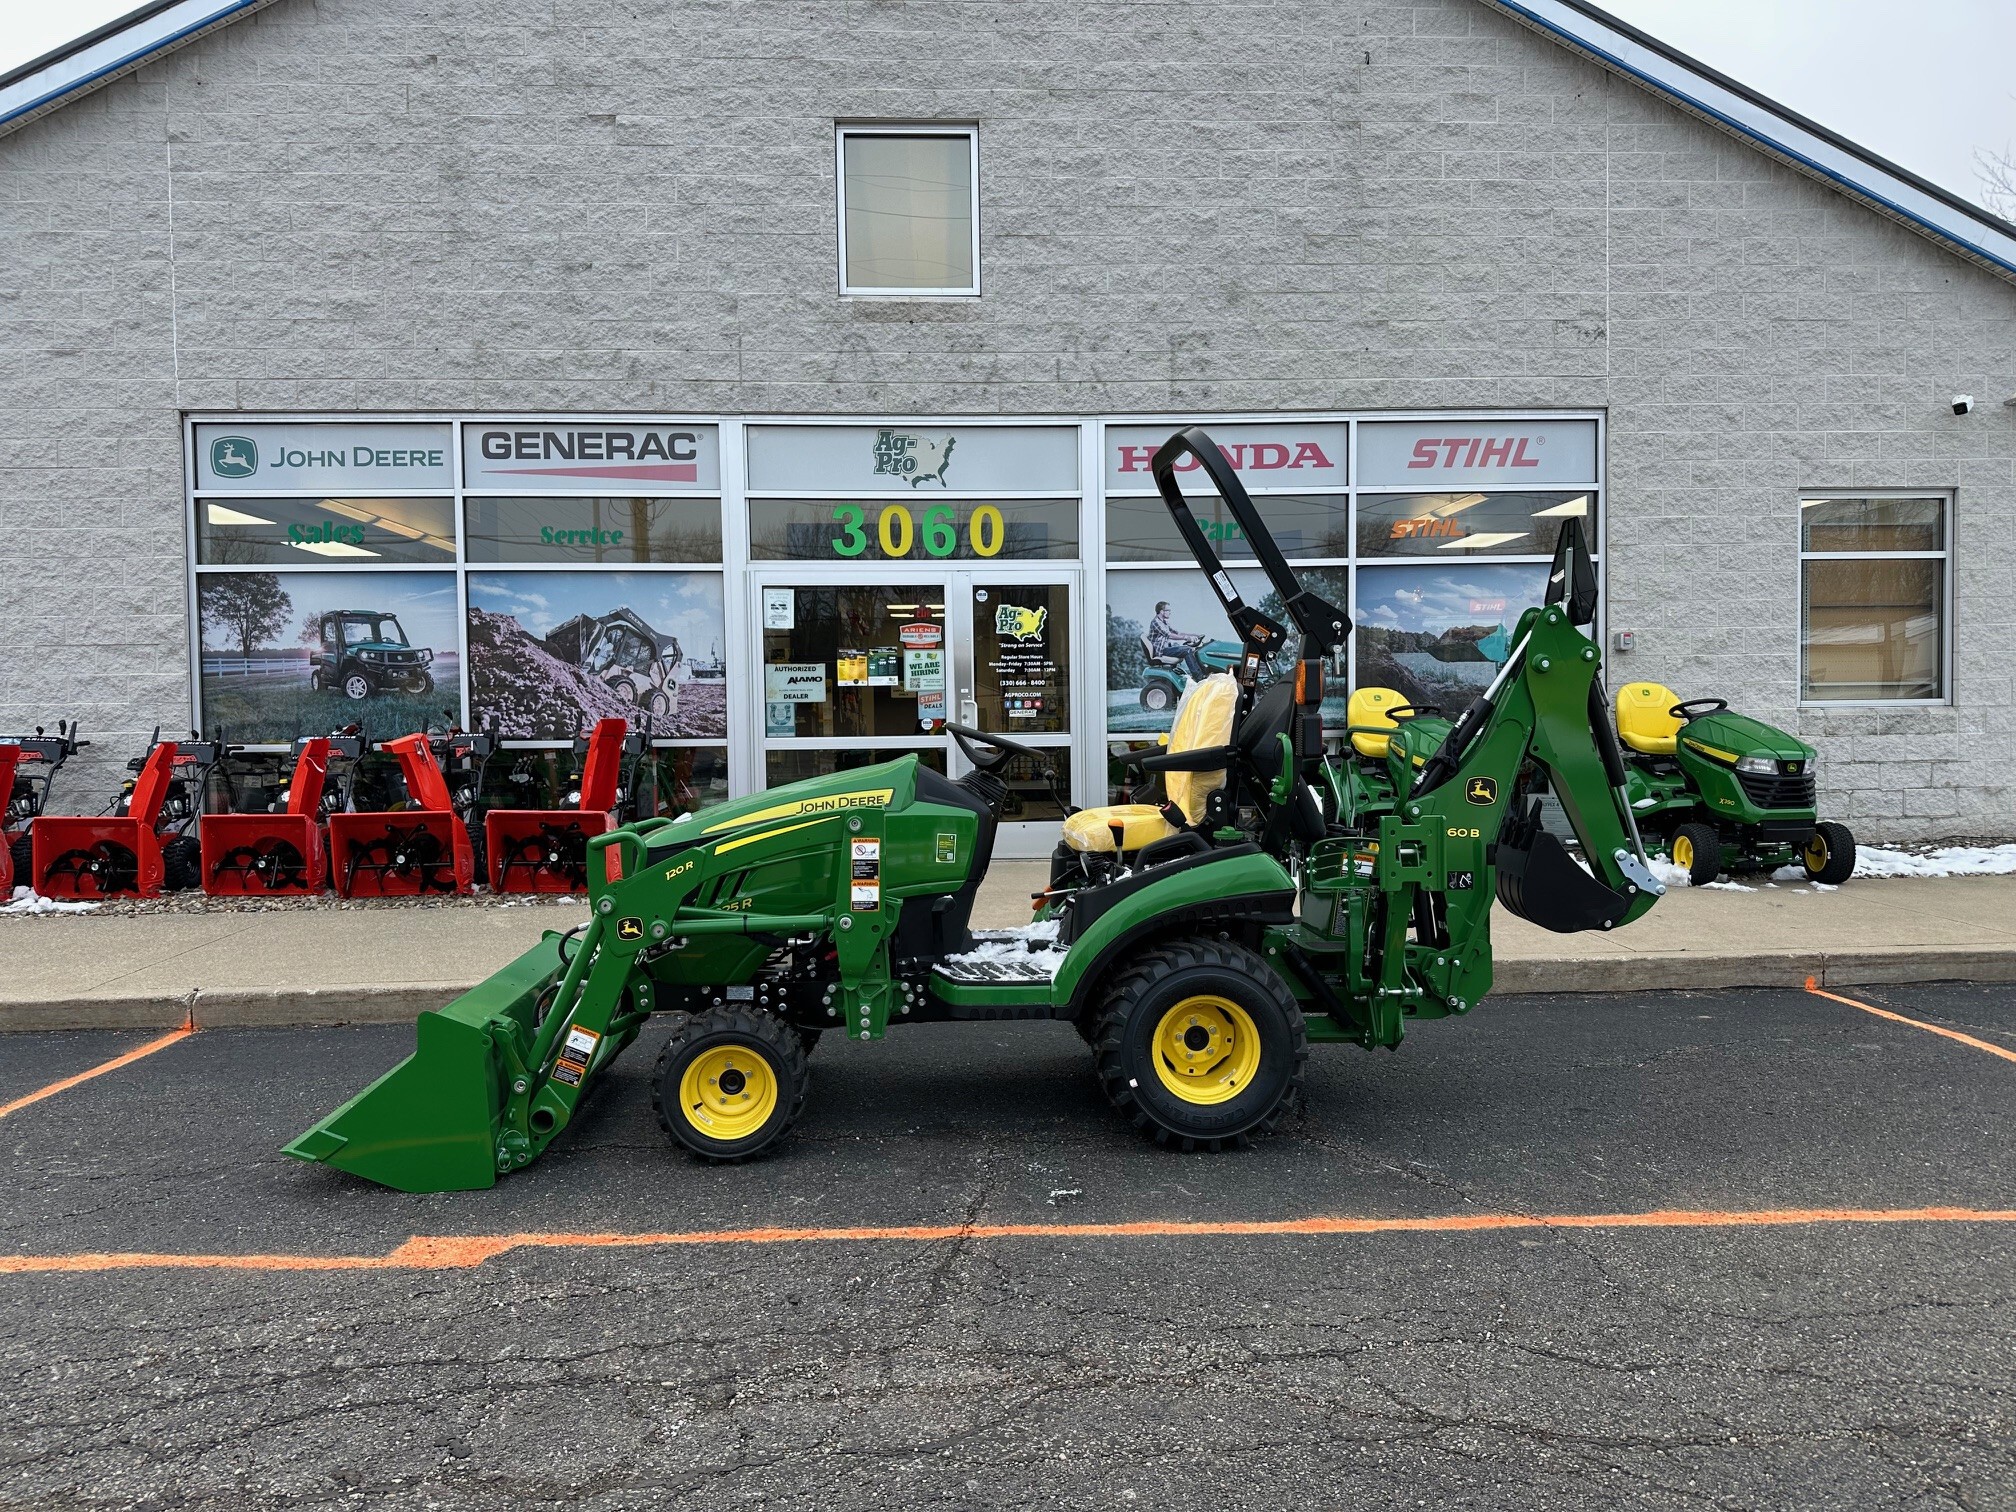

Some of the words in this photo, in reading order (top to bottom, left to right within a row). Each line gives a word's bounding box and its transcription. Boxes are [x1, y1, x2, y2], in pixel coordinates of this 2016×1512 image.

[481, 431, 697, 460] GENERAC
[1407, 437, 1540, 469] STIHL
[874, 452, 917, 474] Pro
[287, 520, 365, 545] Sales
[540, 525, 624, 545] Service
[832, 503, 1004, 557] 3060
[1390, 519, 1466, 539] STIHL
[1473, 602, 1503, 611] STIHL
[999, 620, 1022, 631] Pro
[909, 662, 923, 670] WE
[924, 661, 940, 669] ARE
[911, 668, 940, 677] HIRING
[787, 676, 823, 685] ALAMO
[920, 694, 941, 703] STIHL
[796, 800, 835, 815] JOHN
[839, 795, 885, 808] DEERE
[1447, 828, 1468, 837] 60
[1470, 829, 1480, 838] B
[665, 865, 685, 881] 120
[685, 861, 694, 870] R
[742, 898, 753, 909] R
